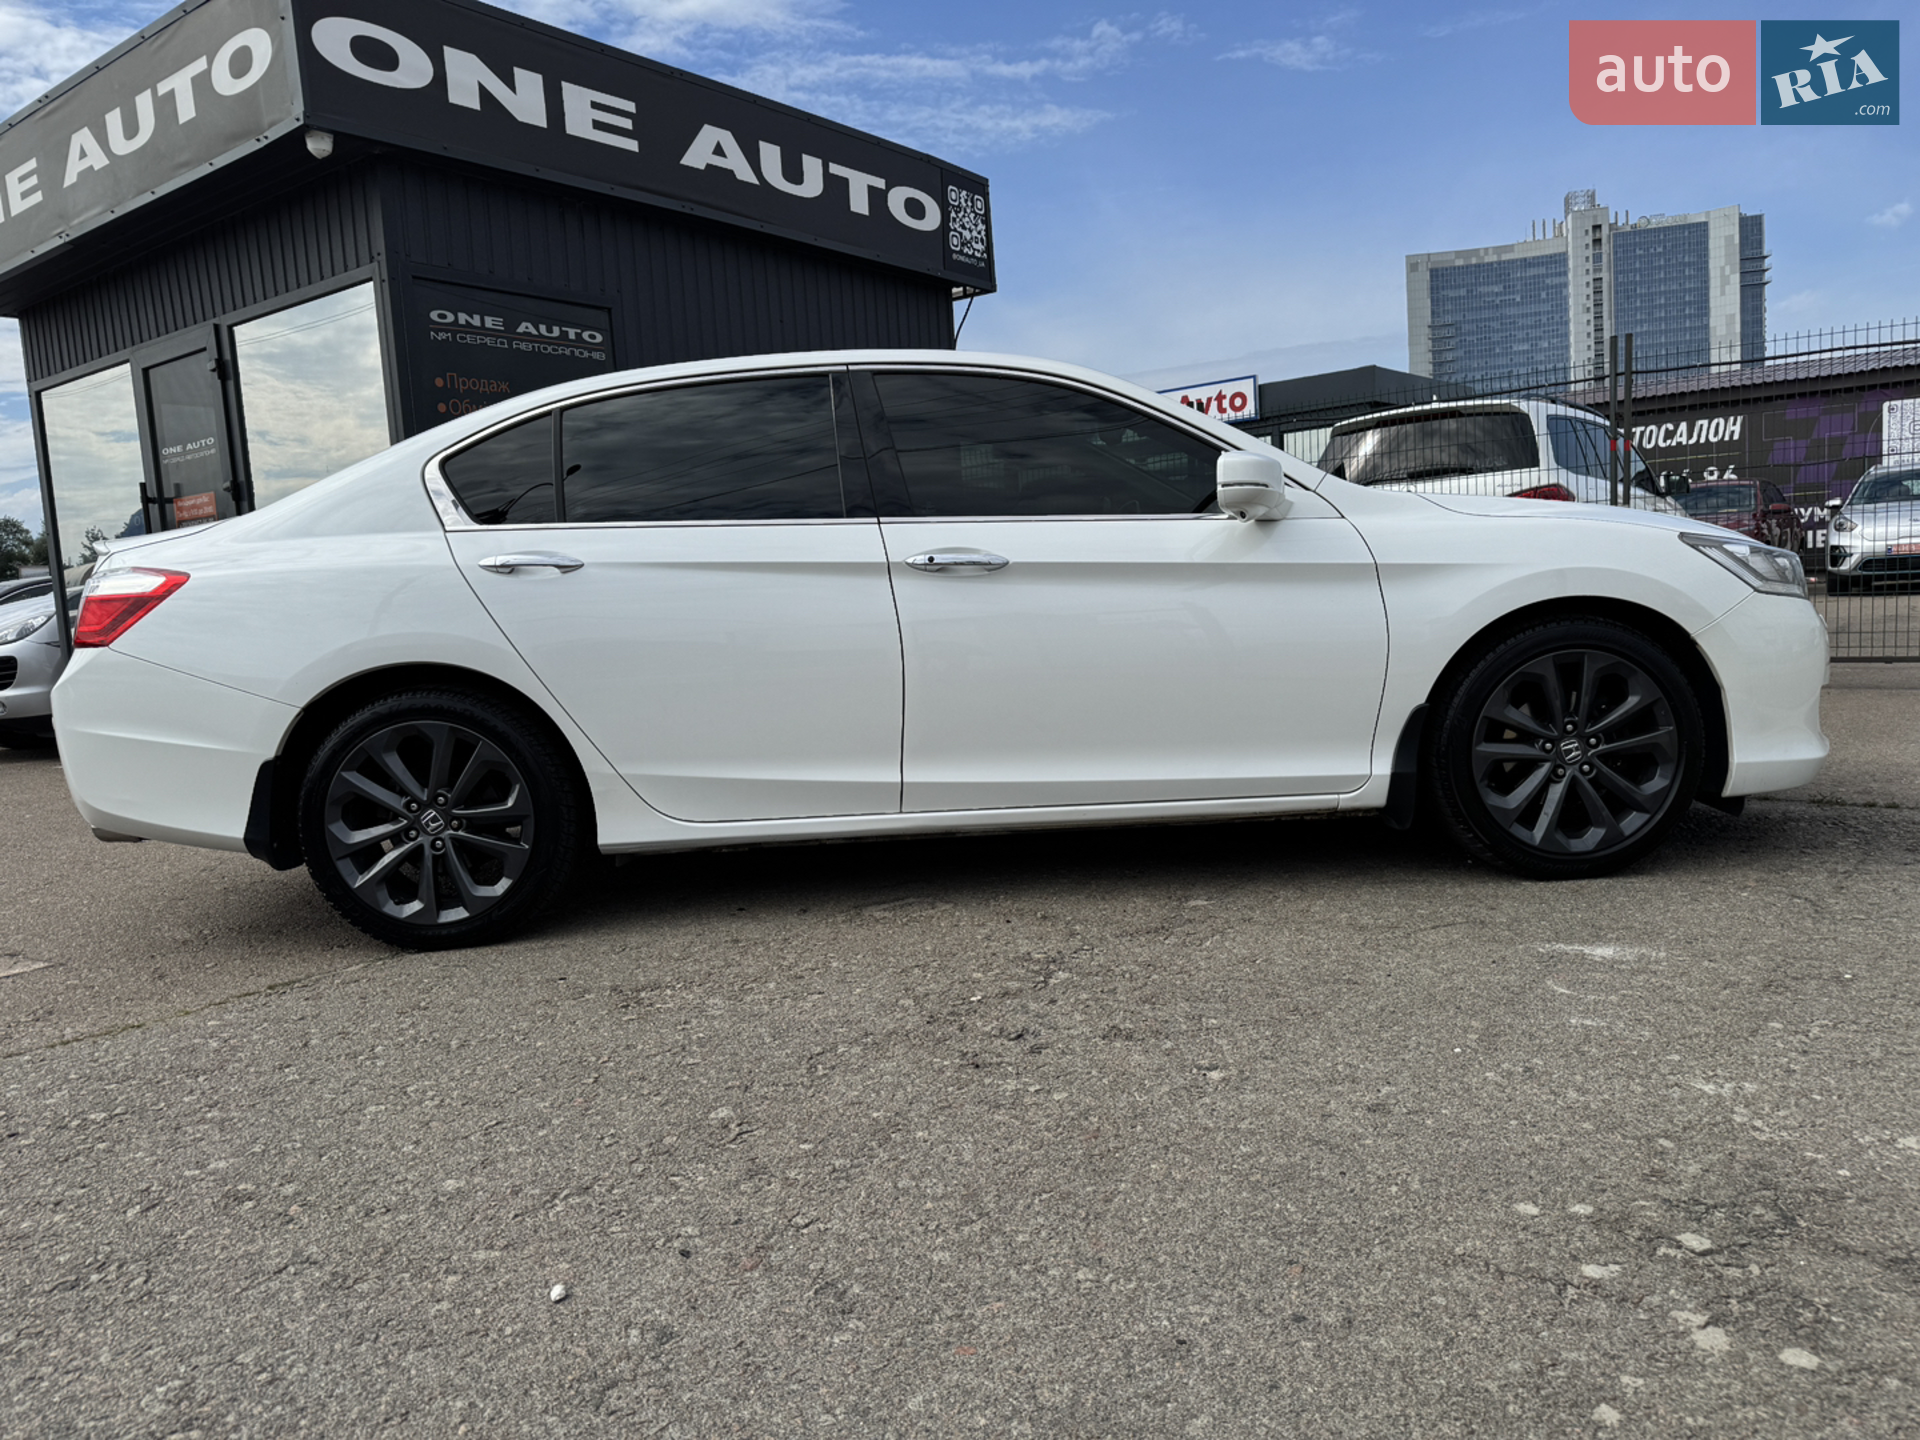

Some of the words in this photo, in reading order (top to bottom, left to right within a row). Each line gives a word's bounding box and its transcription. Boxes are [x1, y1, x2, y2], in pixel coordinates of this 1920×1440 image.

[0, 157, 43, 223] E
[63, 27, 272, 188] AUTO
[311, 16, 639, 152] ONE
[679, 123, 942, 231] AUTO
[429, 309, 505, 330] ONE
[516, 321, 604, 344] AUTO
[456, 333, 509, 348] СЕРЕД
[512, 340, 606, 361] АВТОСАЛОНІВ
[446, 372, 511, 394] Продаж
[162, 444, 183, 455] ONE
[186, 437, 215, 451] AUTO
[1631, 415, 1744, 449] ТОСАЛОН
